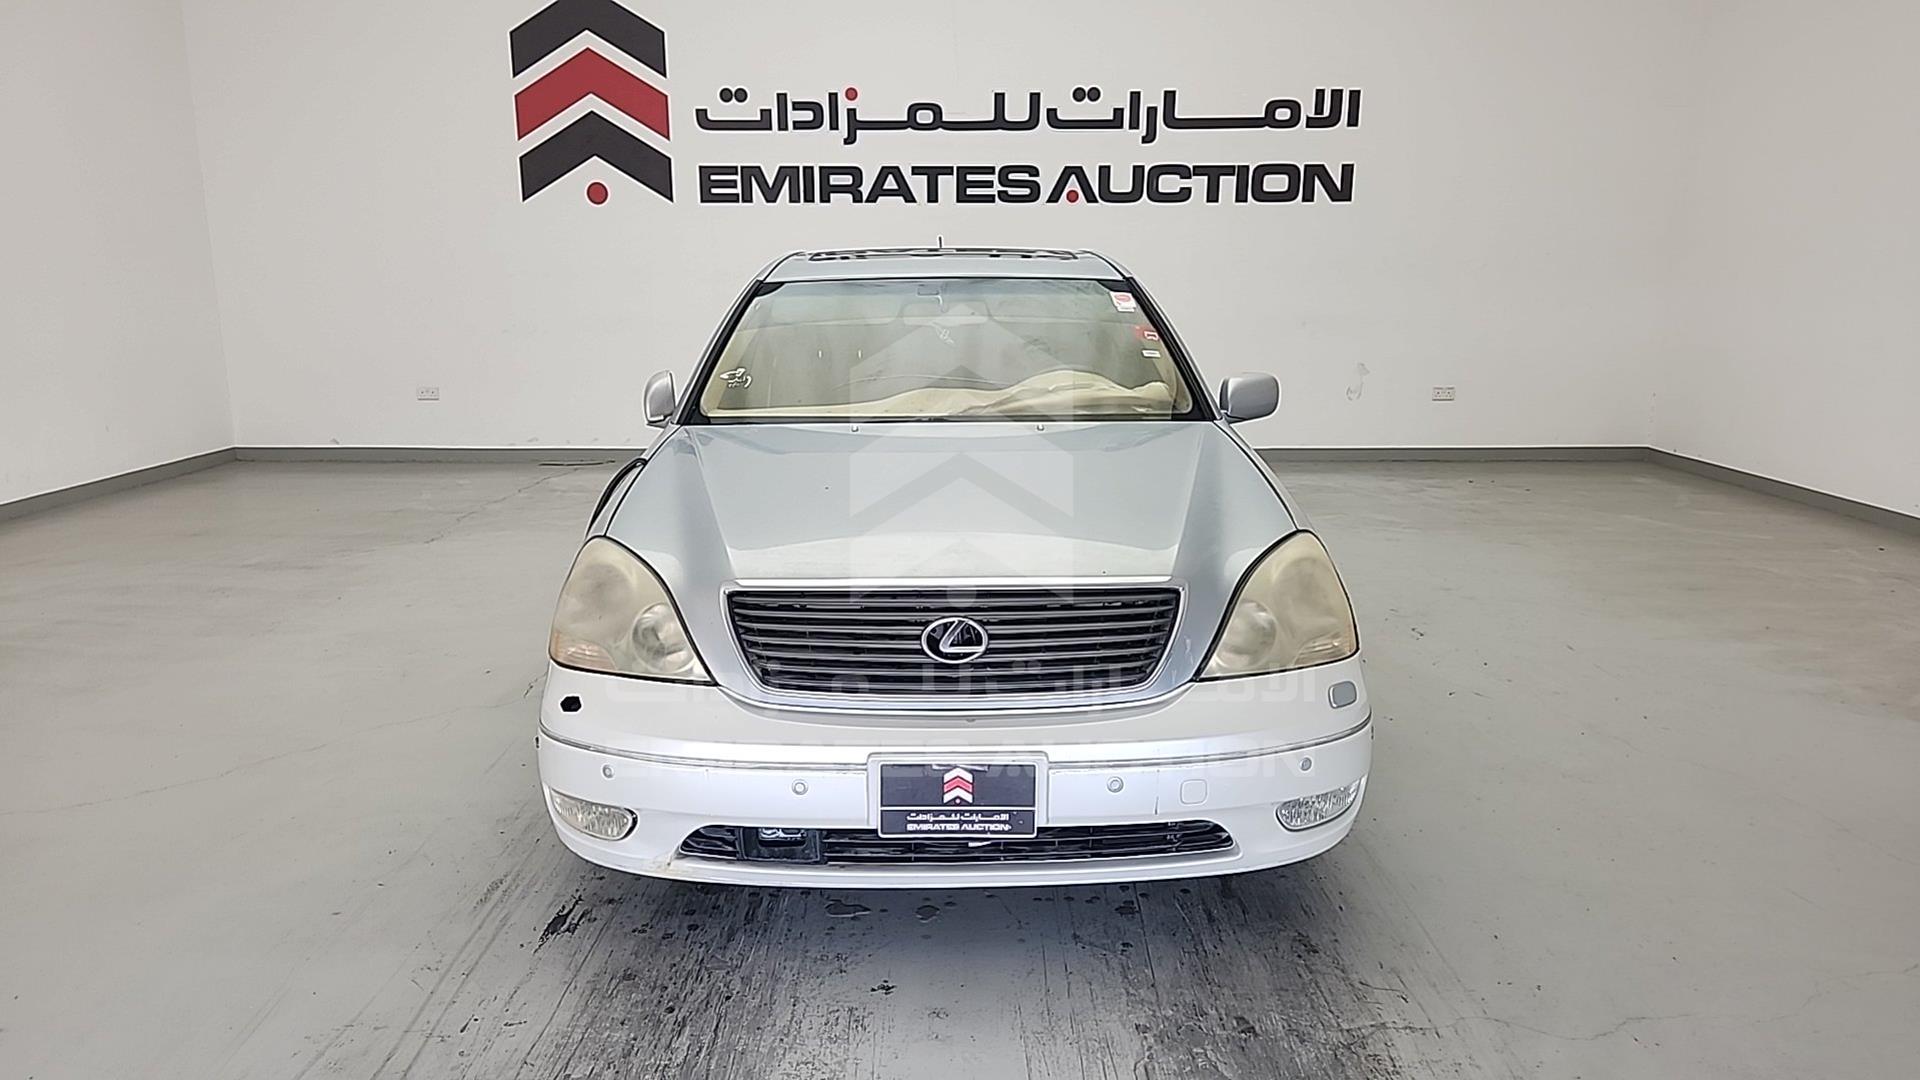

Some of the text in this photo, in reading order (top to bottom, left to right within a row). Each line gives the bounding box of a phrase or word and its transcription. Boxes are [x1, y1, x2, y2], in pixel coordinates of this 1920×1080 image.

[695, 87, 1362, 146] الامارات للمزادات
[698, 164, 1355, 204] EMIRATES AUCTION
[906, 823, 960, 831] EMIRATES
